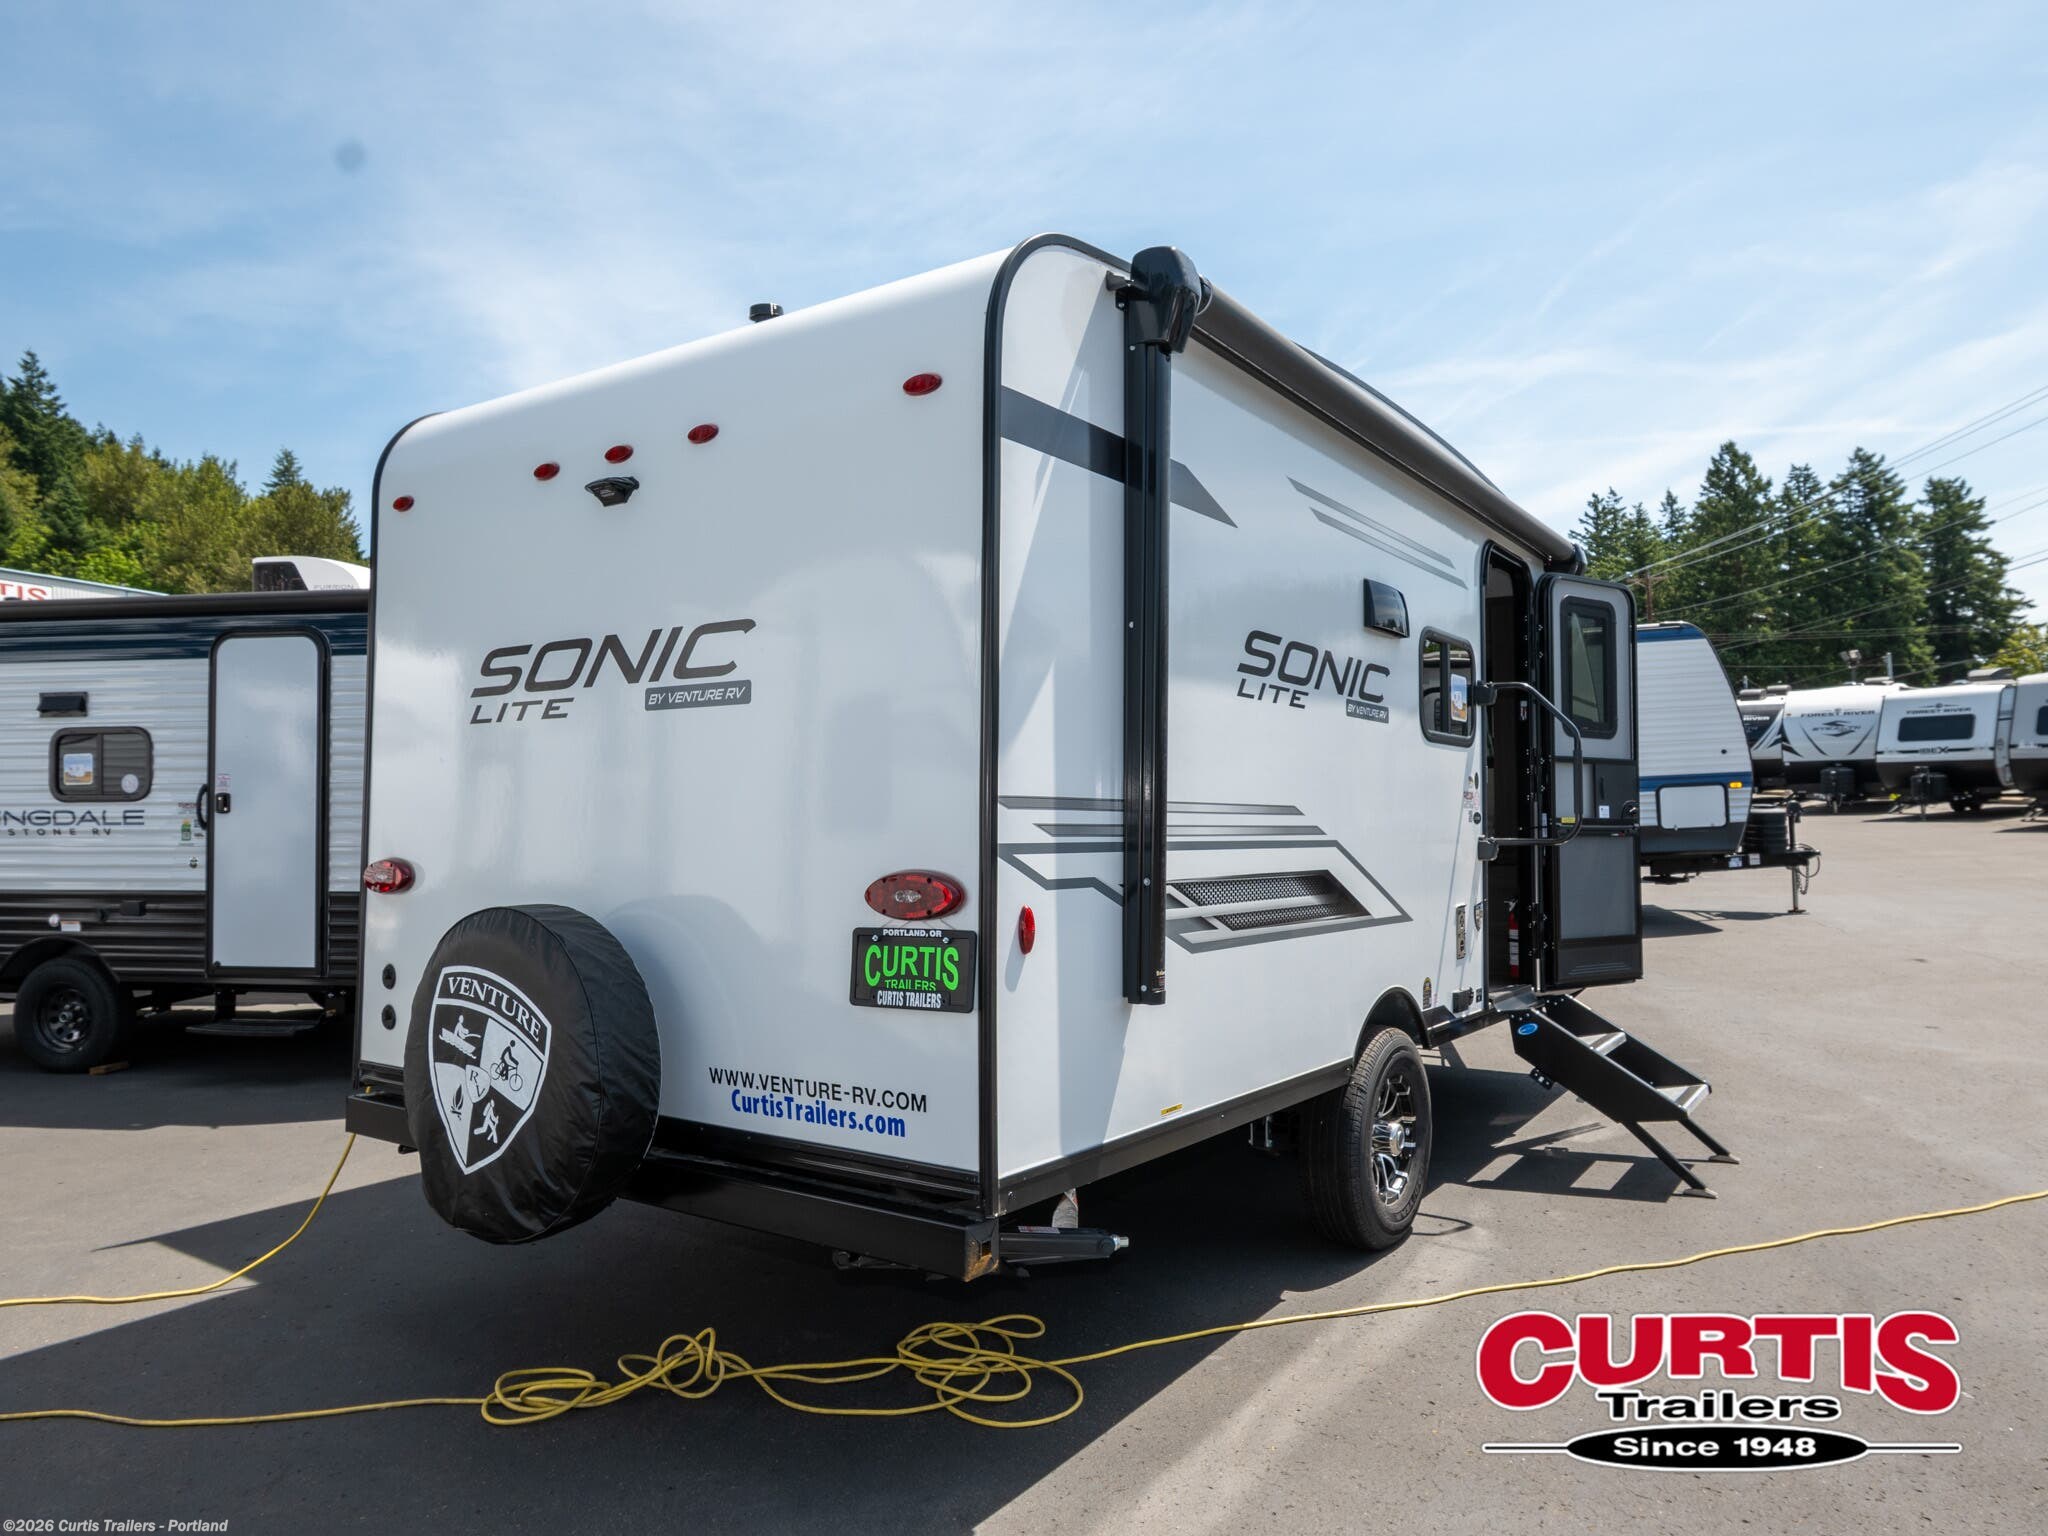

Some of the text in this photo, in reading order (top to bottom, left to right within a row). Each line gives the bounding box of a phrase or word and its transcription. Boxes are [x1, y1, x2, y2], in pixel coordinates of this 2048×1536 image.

[470, 618, 757, 698] SONIC
[1237, 629, 1391, 704] SONIC
[648, 686, 747, 705] BY VENTURE RV
[1236, 678, 1309, 709] LITE
[470, 697, 575, 724] LITE
[1347, 703, 1387, 719] BY VENTURE RV
[0, 810, 145, 826] NGDALE
[92, 828, 112, 836] RV
[882, 928, 942, 938] PORTLAND, OR
[864, 944, 960, 991] CURTIS
[448, 976, 542, 1042] VENTURE
[877, 990, 942, 1009] CURTIS TRAILERS
[709, 1067, 927, 1113] WWW.VENTURE-RV.COM
[731, 1089, 906, 1138] CurtisTrailers.com
